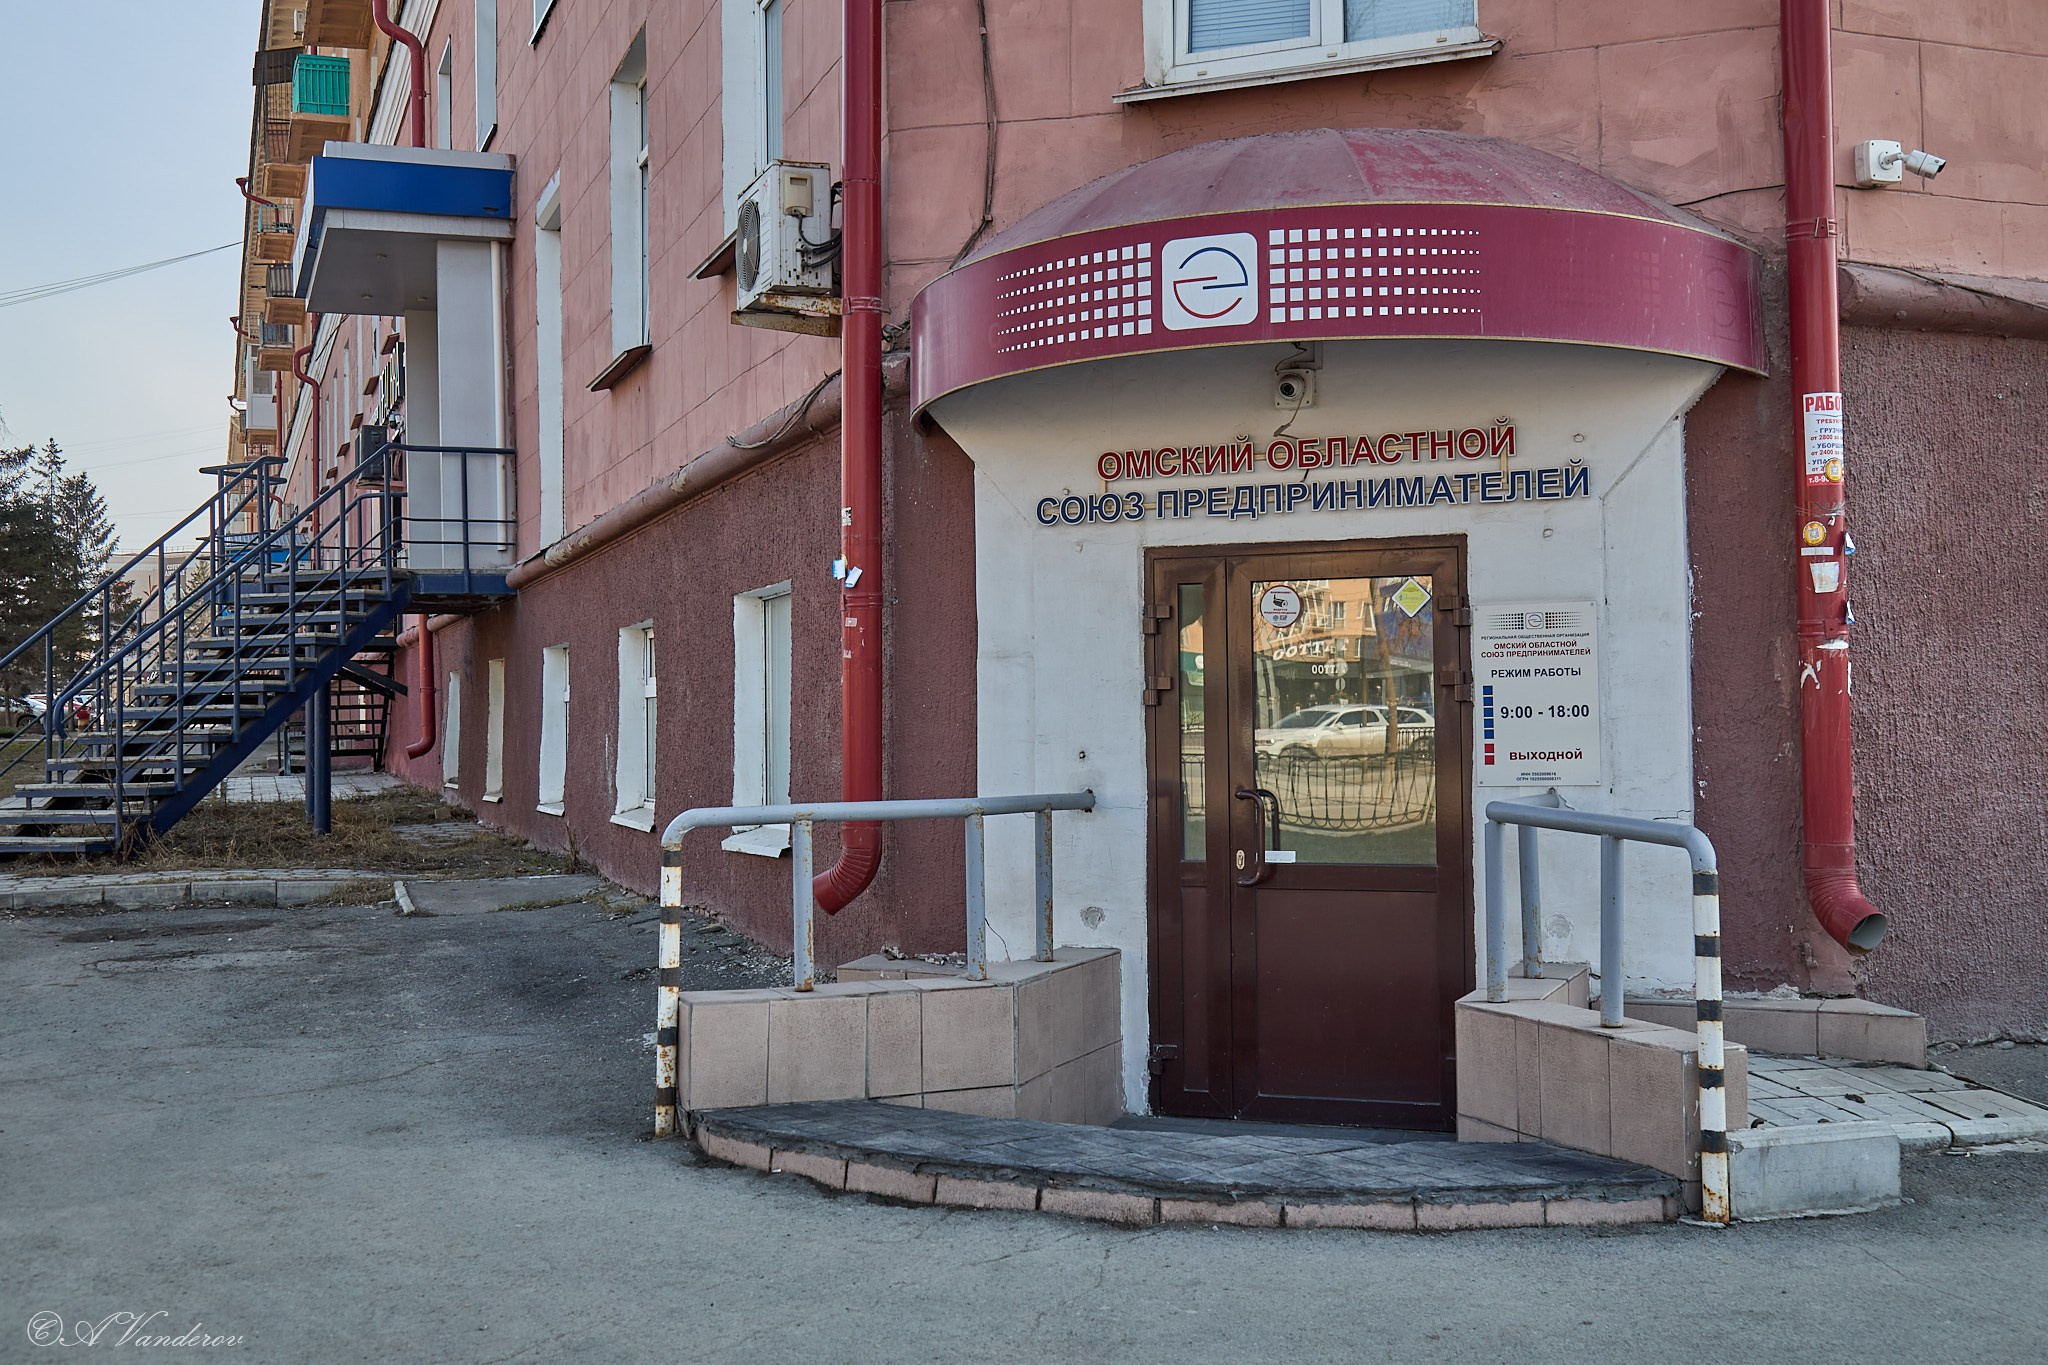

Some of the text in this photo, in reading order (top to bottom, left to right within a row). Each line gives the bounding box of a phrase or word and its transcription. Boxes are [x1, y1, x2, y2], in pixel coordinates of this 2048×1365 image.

[1805, 396, 1842, 412] РАБО
[1097, 416, 1518, 481] ОМСКИЙ ОБЛАСТНОЙ
[1036, 457, 1591, 527] СОЮЗ ПРЕДПРИНИМАТЕЛЕЙ
[1494, 640, 1577, 649] ОМСКИЙ ОБЛАСТНОЙ
[1507, 647, 1591, 658] ПРЕДПРИНИМАТЕЛЕЙ
[1491, 667, 1581, 678] РЕЖИМ РАБОТЫ
[1501, 706, 1532, 718] 9:00
[1548, 704, 1590, 718] 18:00
